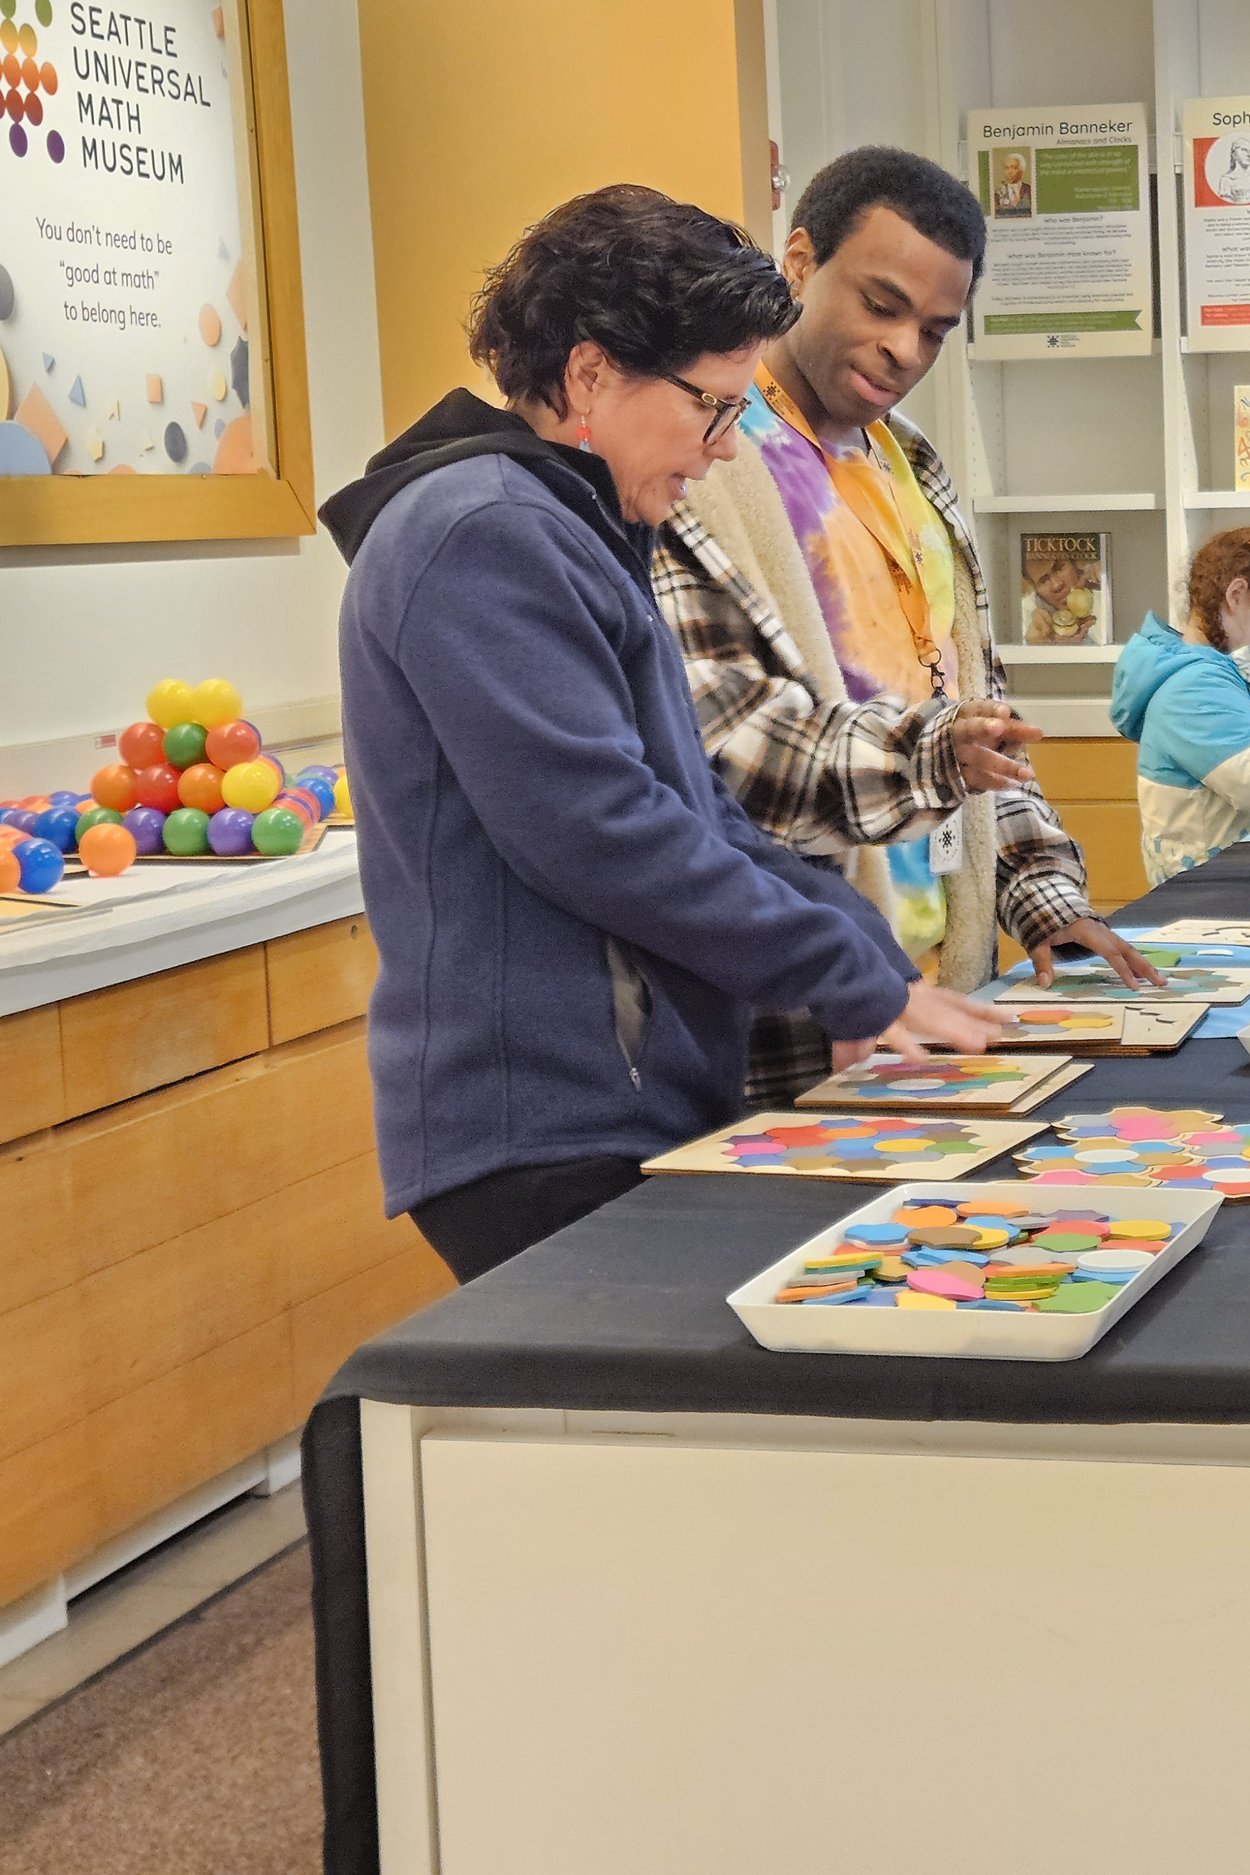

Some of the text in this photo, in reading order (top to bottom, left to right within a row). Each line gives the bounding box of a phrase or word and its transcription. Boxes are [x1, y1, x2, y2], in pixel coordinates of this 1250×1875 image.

[71, 2, 178, 58] SEATTLE
[73, 46, 211, 107] UNIVERSAL
[77, 91, 142, 134] MATH
[983, 120, 1133, 140] Benjamin Banneker
[1056, 138, 1091, 146] Almanacs
[1109, 136, 1132, 144] Clocks
[82, 136, 185, 184] MUSEUM
[36, 217, 173, 254] You don't need to be
[104, 268, 118, 287] at
[64, 301, 161, 330] to belong here.
[1025, 538, 1095, 551] TICKTOCK
